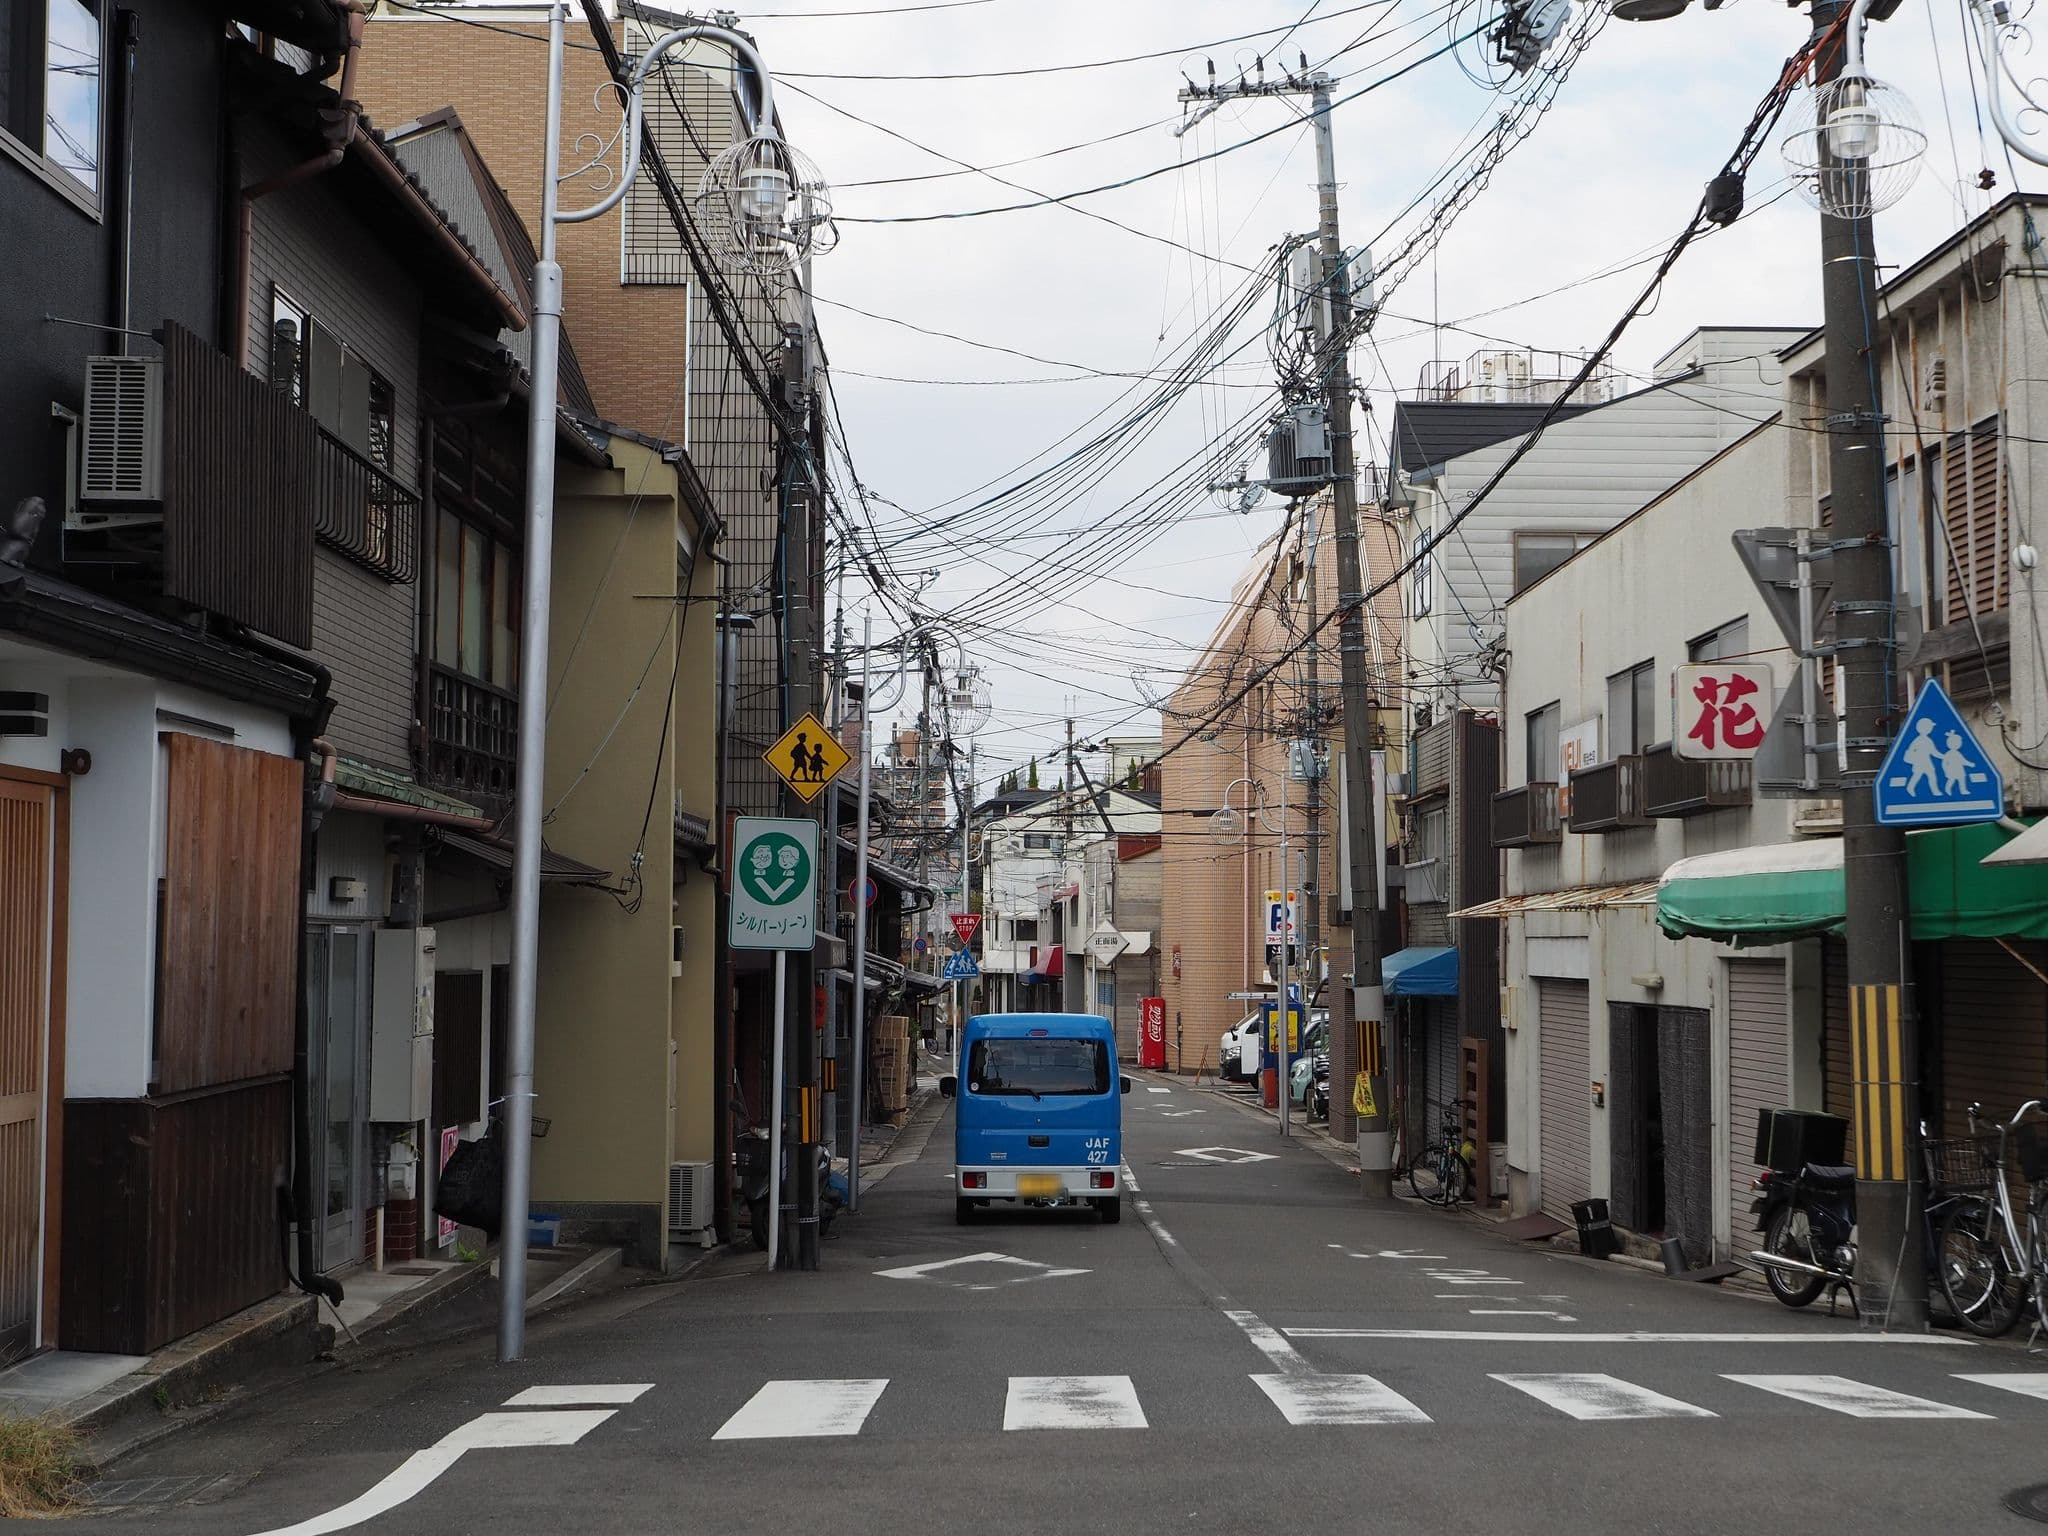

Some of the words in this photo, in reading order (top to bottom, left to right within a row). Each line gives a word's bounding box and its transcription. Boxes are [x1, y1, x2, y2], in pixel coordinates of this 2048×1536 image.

[1688, 673, 1766, 750] 花
[956, 917, 975, 925] 止まれ
[1149, 1004, 1161, 1042] Coca-Cola
[1085, 1137, 1110, 1149] JAF
[1087, 1150, 1109, 1163] 427
